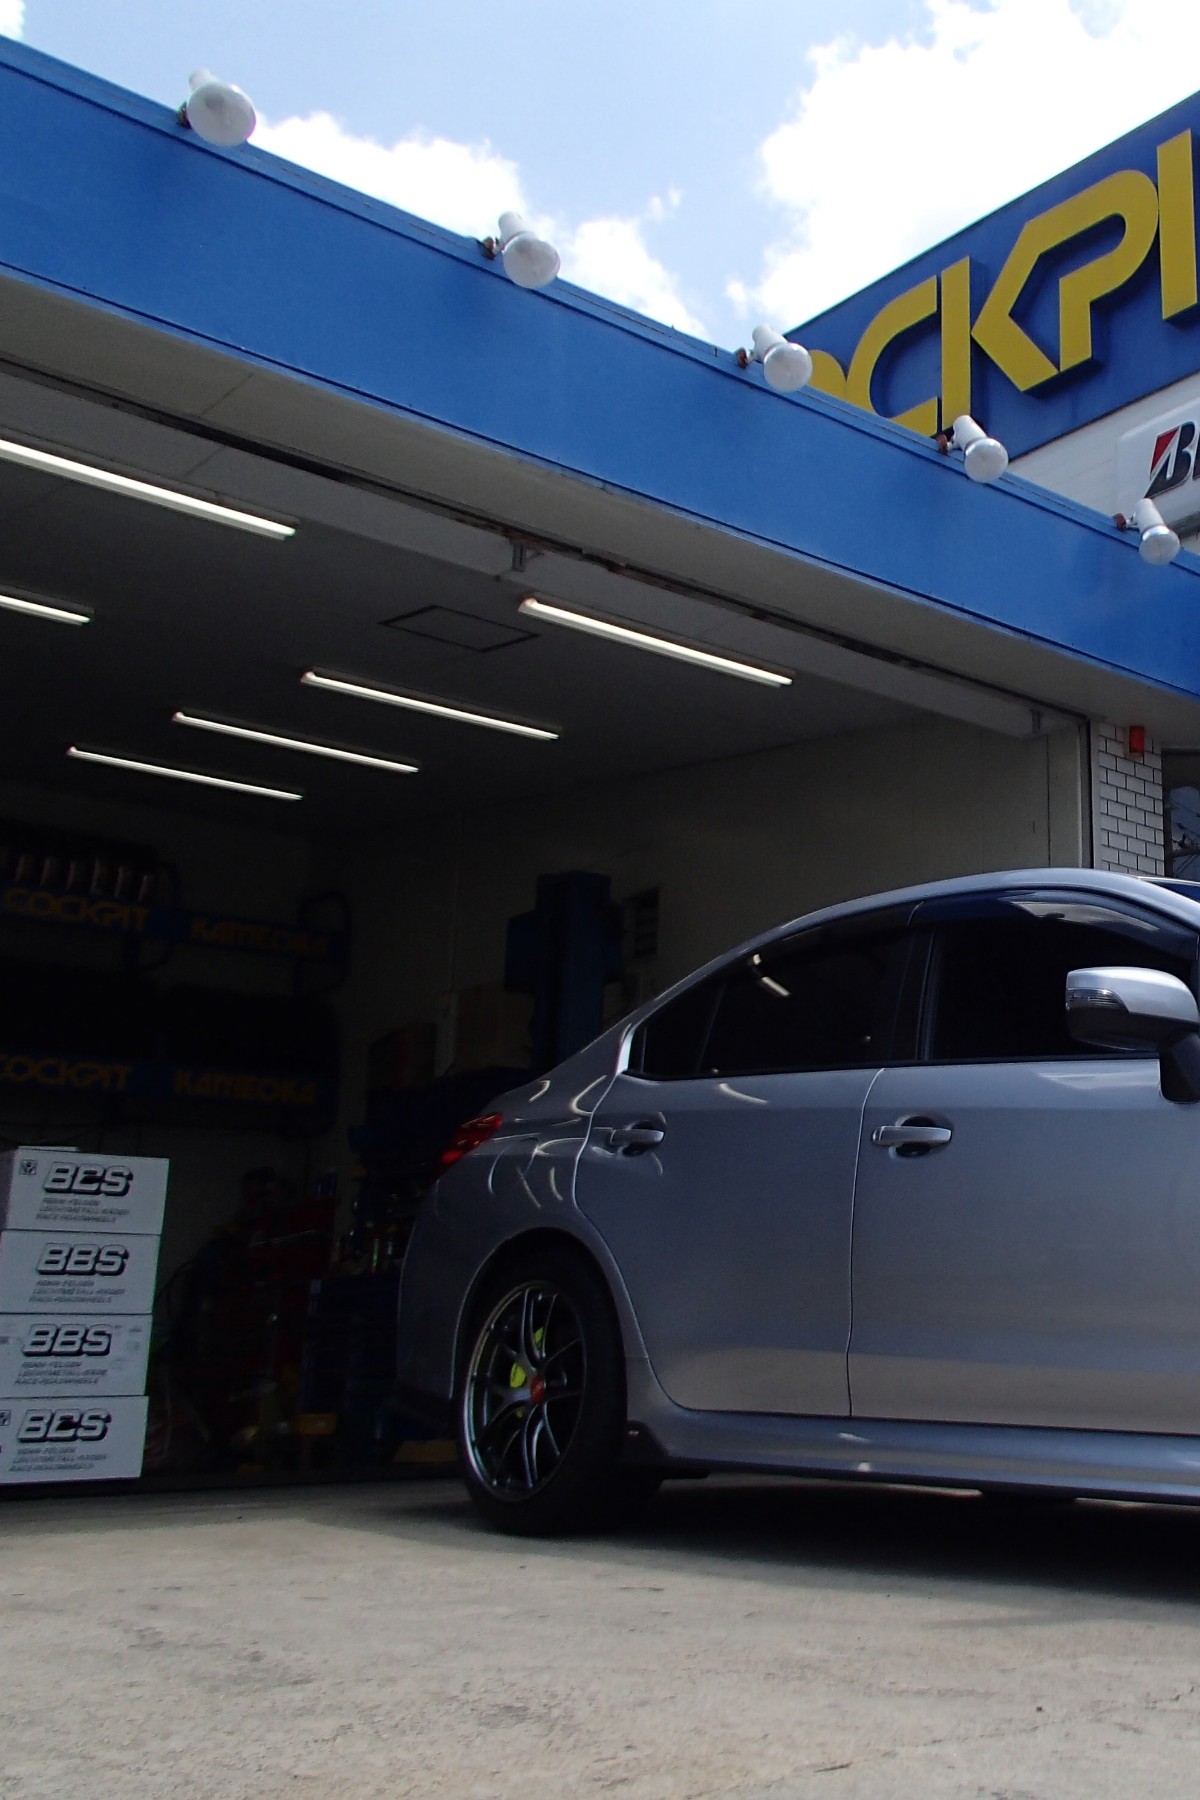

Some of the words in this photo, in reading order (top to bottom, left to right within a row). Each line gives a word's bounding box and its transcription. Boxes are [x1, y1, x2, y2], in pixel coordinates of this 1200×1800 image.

[3, 886, 151, 932] COCKPIT
[43, 1161, 134, 1197] BBS
[36, 1242, 129, 1276] BBS
[22, 1323, 112, 1357] BBS
[17, 1408, 112, 1443] BBS
